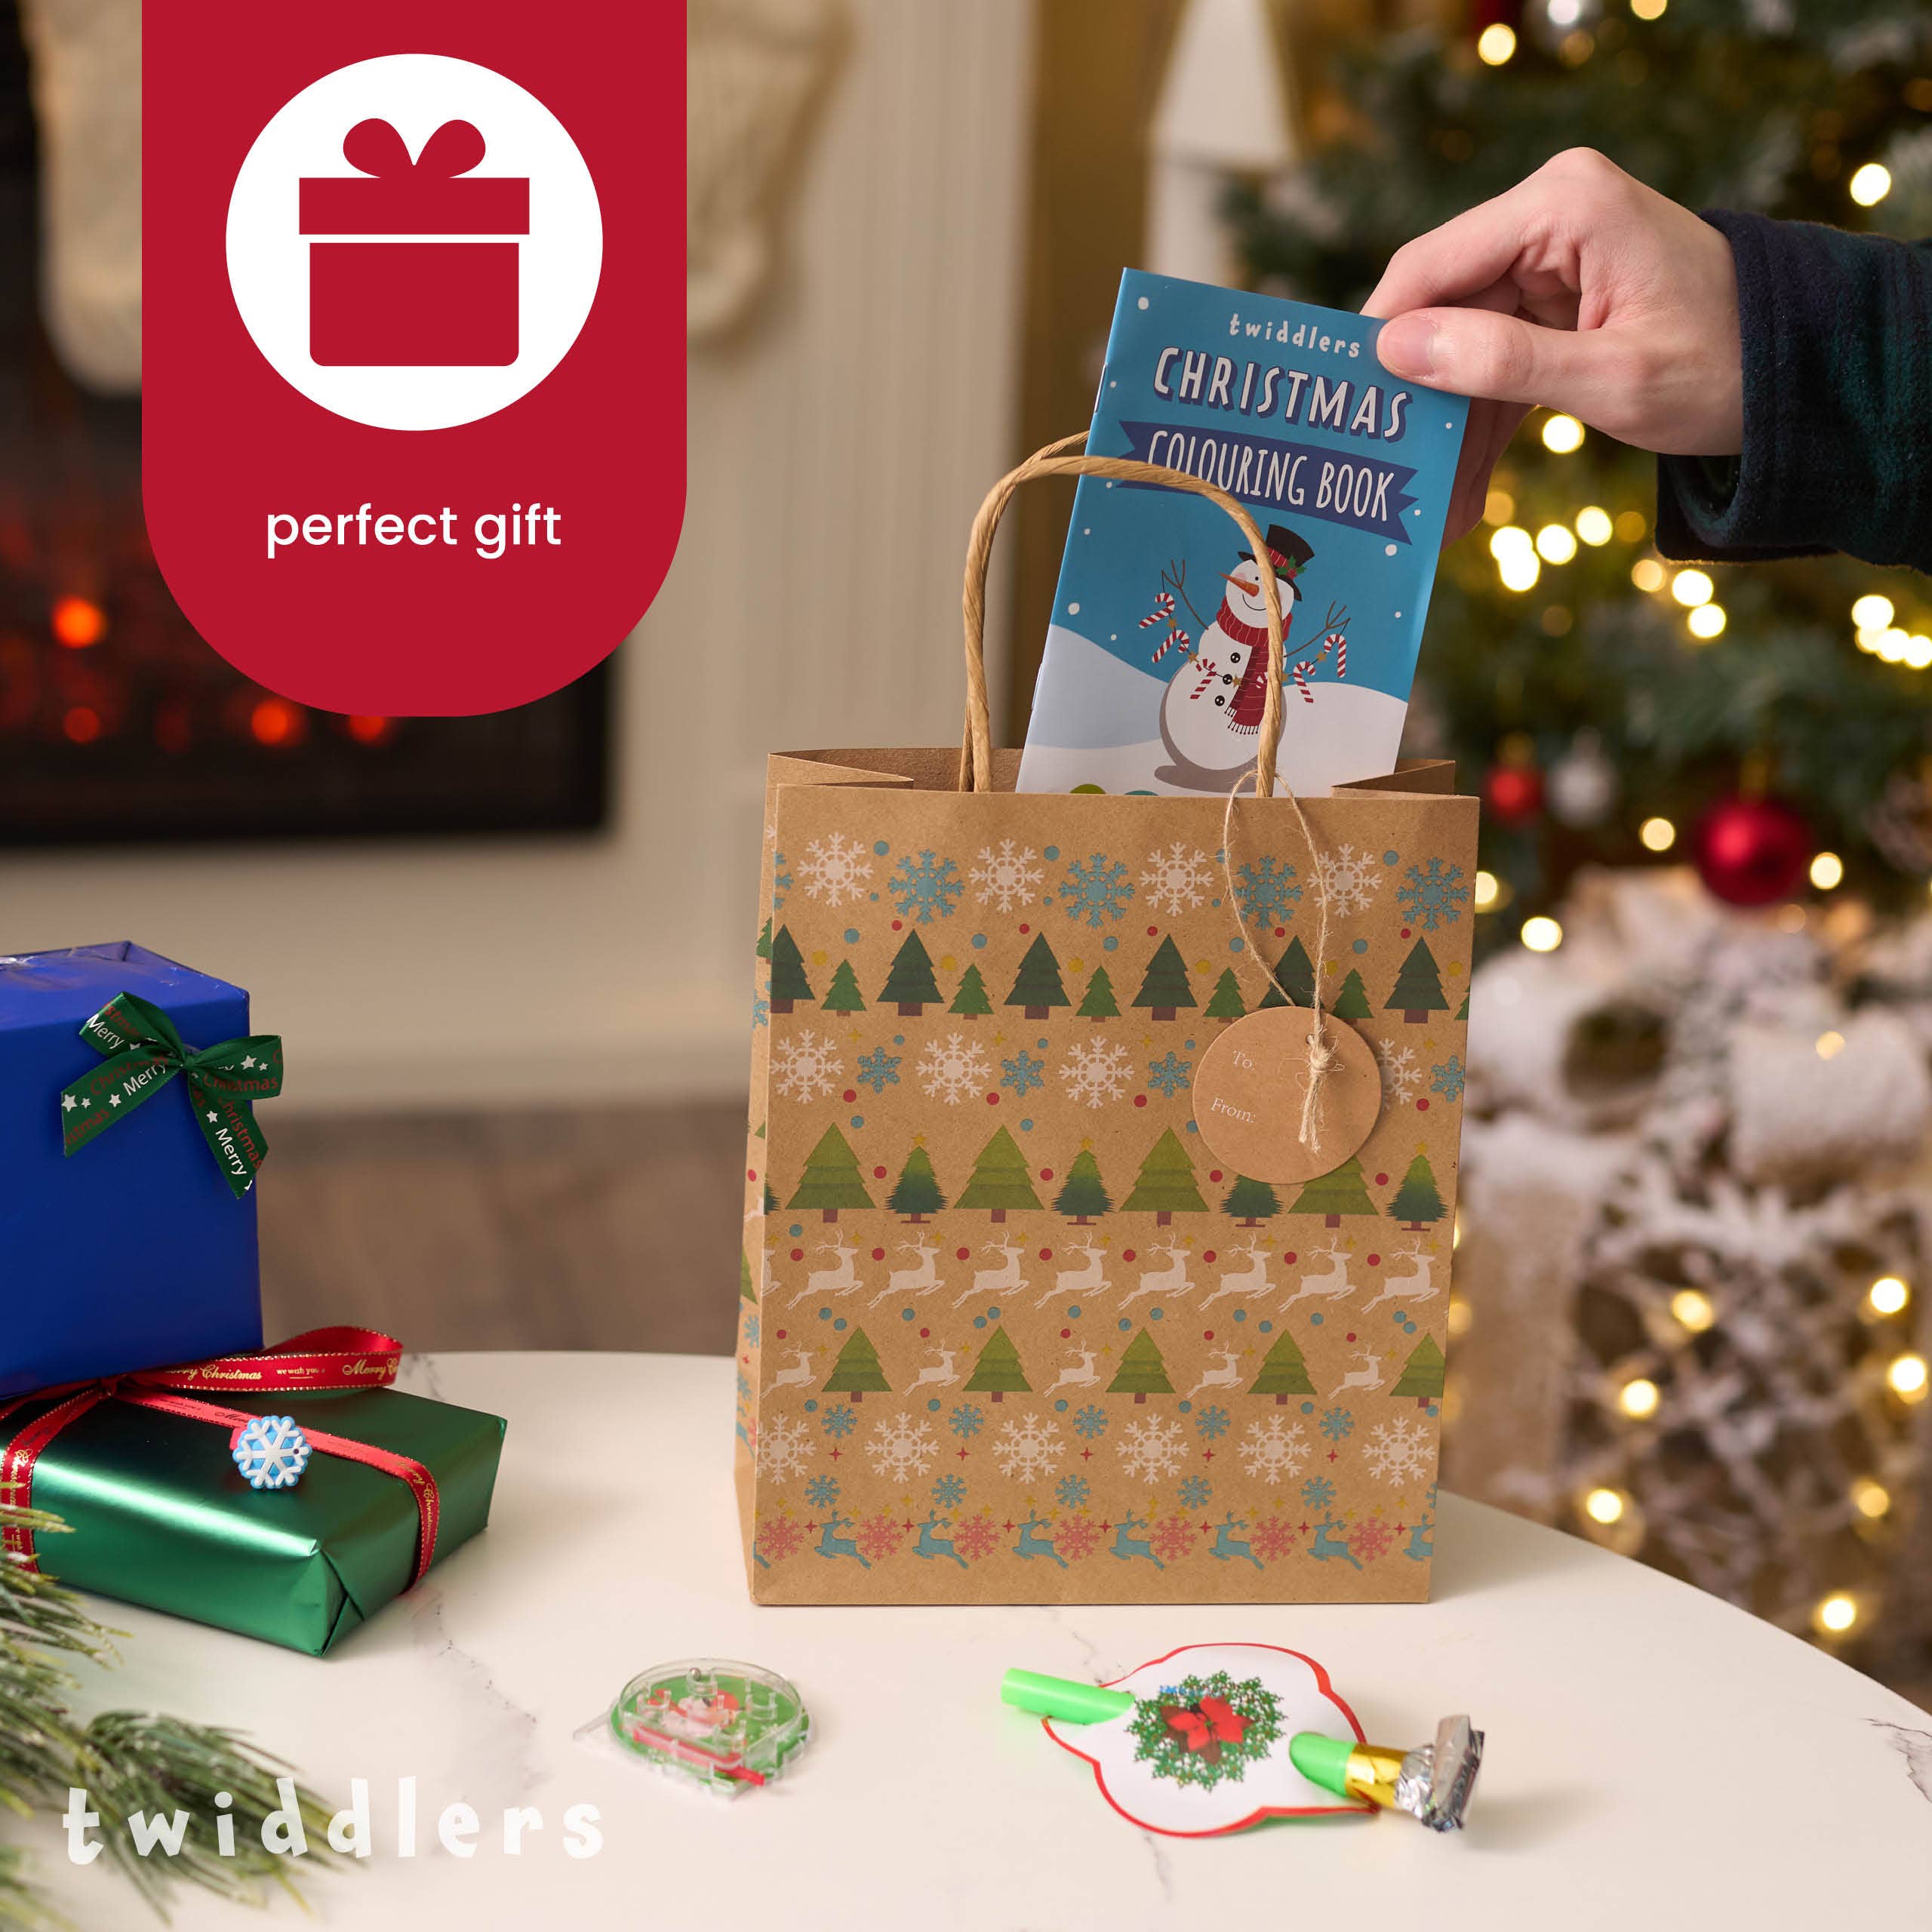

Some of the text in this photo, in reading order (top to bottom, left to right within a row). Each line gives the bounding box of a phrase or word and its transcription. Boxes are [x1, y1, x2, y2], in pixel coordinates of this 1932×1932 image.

[1229, 313, 1361, 358] twiddlers
[1153, 346, 1413, 443] CHRISTMAS
[1148, 430, 1396, 521] COLOURING BOOK
[85, 1013, 125, 1050] Merry
[1231, 1050, 1256, 1071] To:
[123, 1063, 167, 1097] Merry
[1211, 1097, 1257, 1124] From:
[215, 1127, 248, 1176] Merry
[199, 1364, 263, 1380] Christmas
[342, 1358, 386, 1381] Merry
